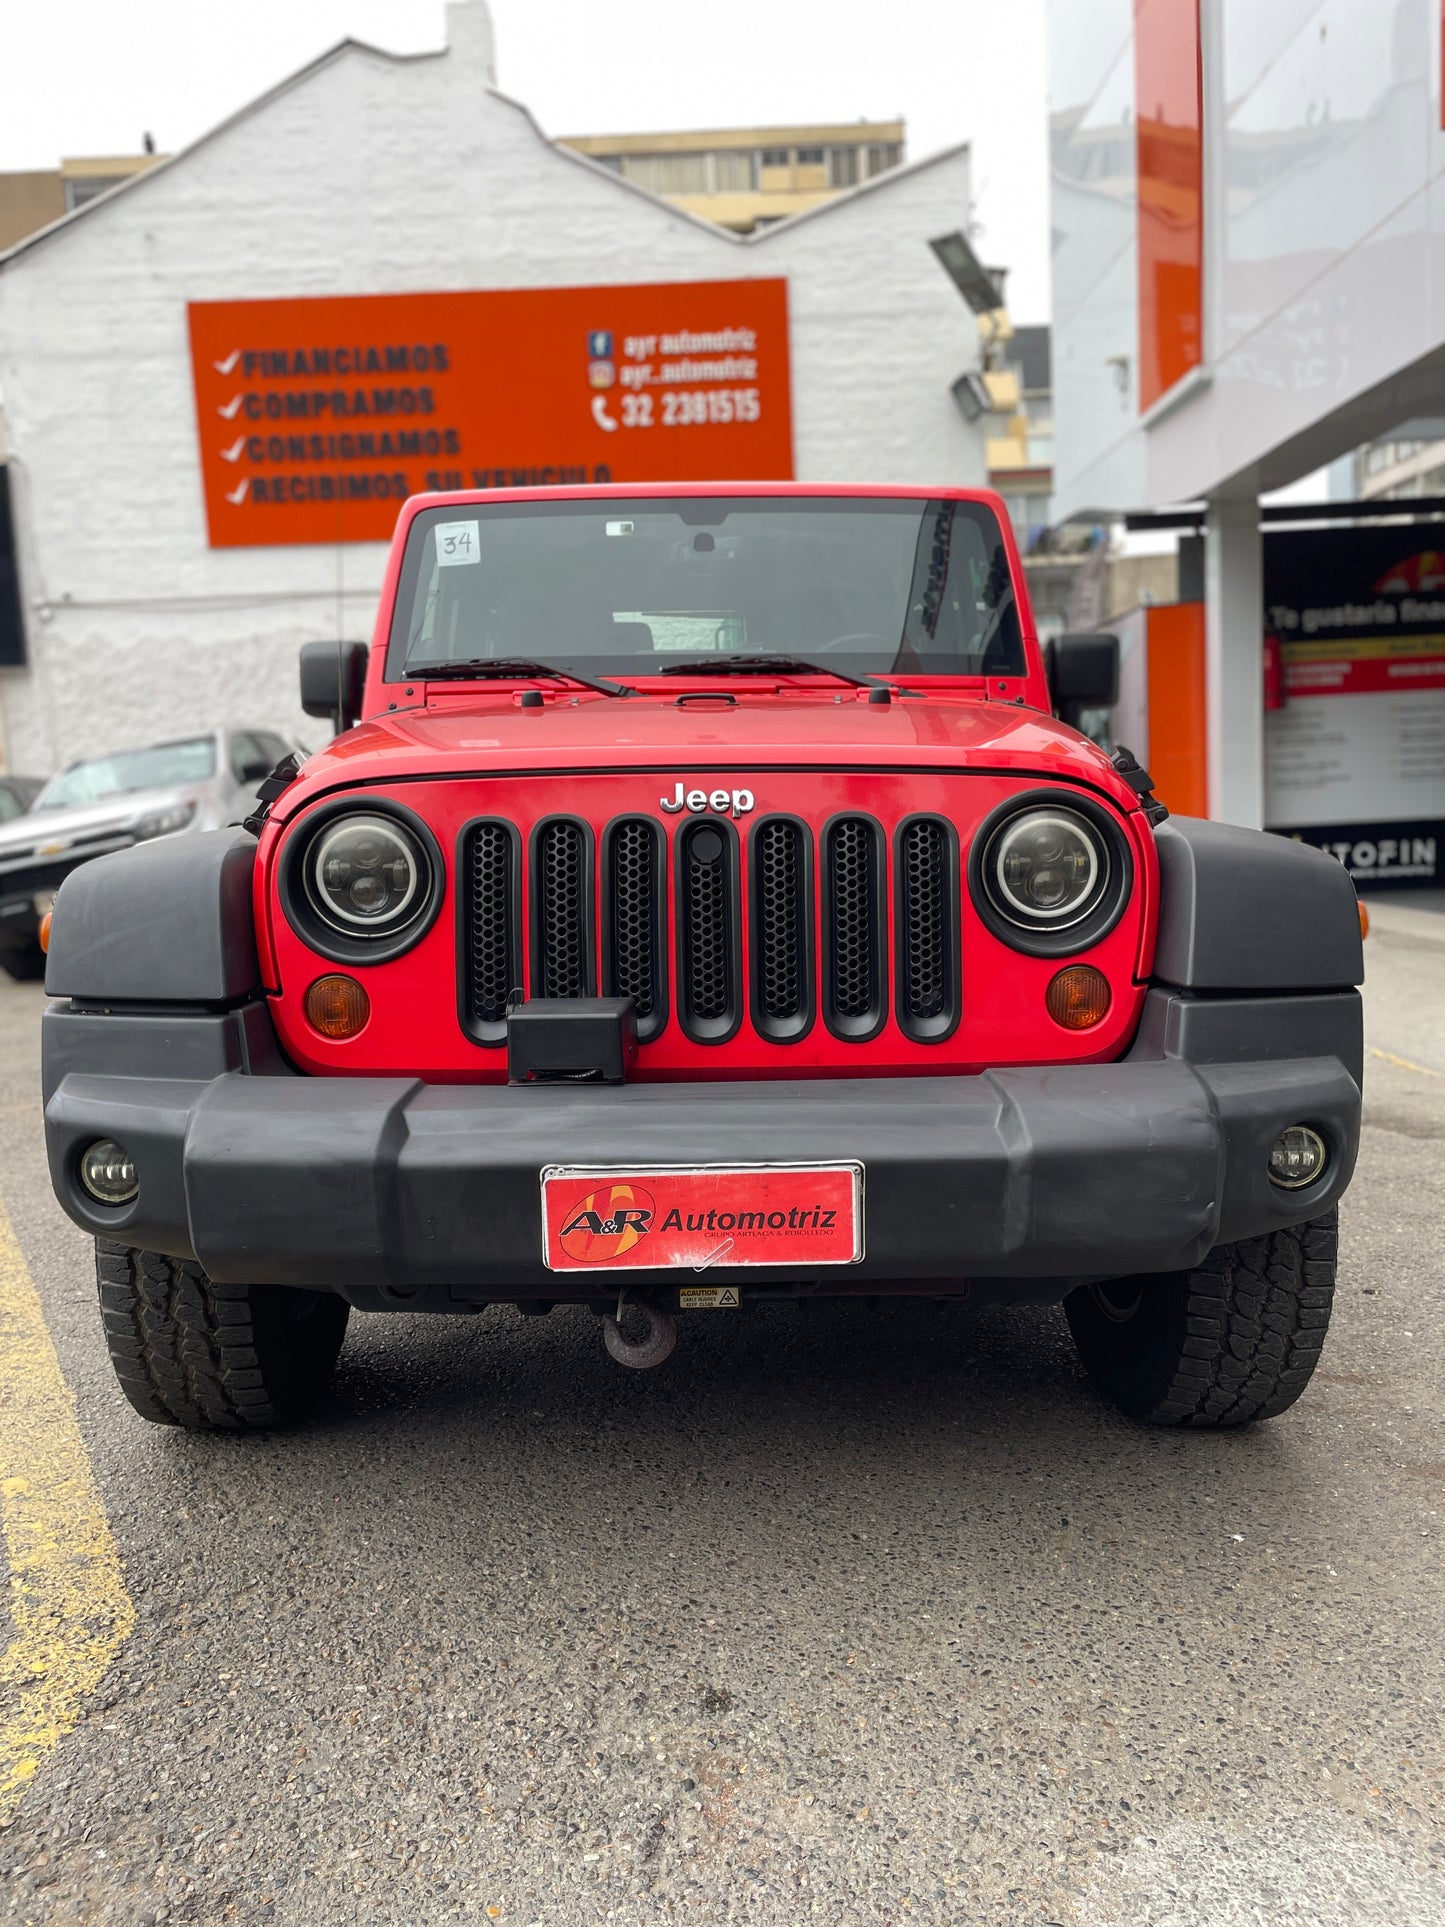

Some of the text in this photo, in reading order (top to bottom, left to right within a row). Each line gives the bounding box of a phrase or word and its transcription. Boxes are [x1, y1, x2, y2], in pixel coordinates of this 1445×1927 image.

[243, 344, 449, 378] FINANCIAMOS
[623, 328, 756, 361] ayr automotriz
[244, 387, 435, 420] COMPRAMOS
[621, 388, 760, 427] 32 2381515
[247, 429, 460, 463] CONSIGNAMOS
[252, 472, 409, 504] RECIBIMOS
[443, 532, 472, 554] 34
[660, 782, 755, 819] Jeep
[1321, 837, 1437, 867] TOFIN
[559, 1205, 837, 1236] A&R Automotriz
